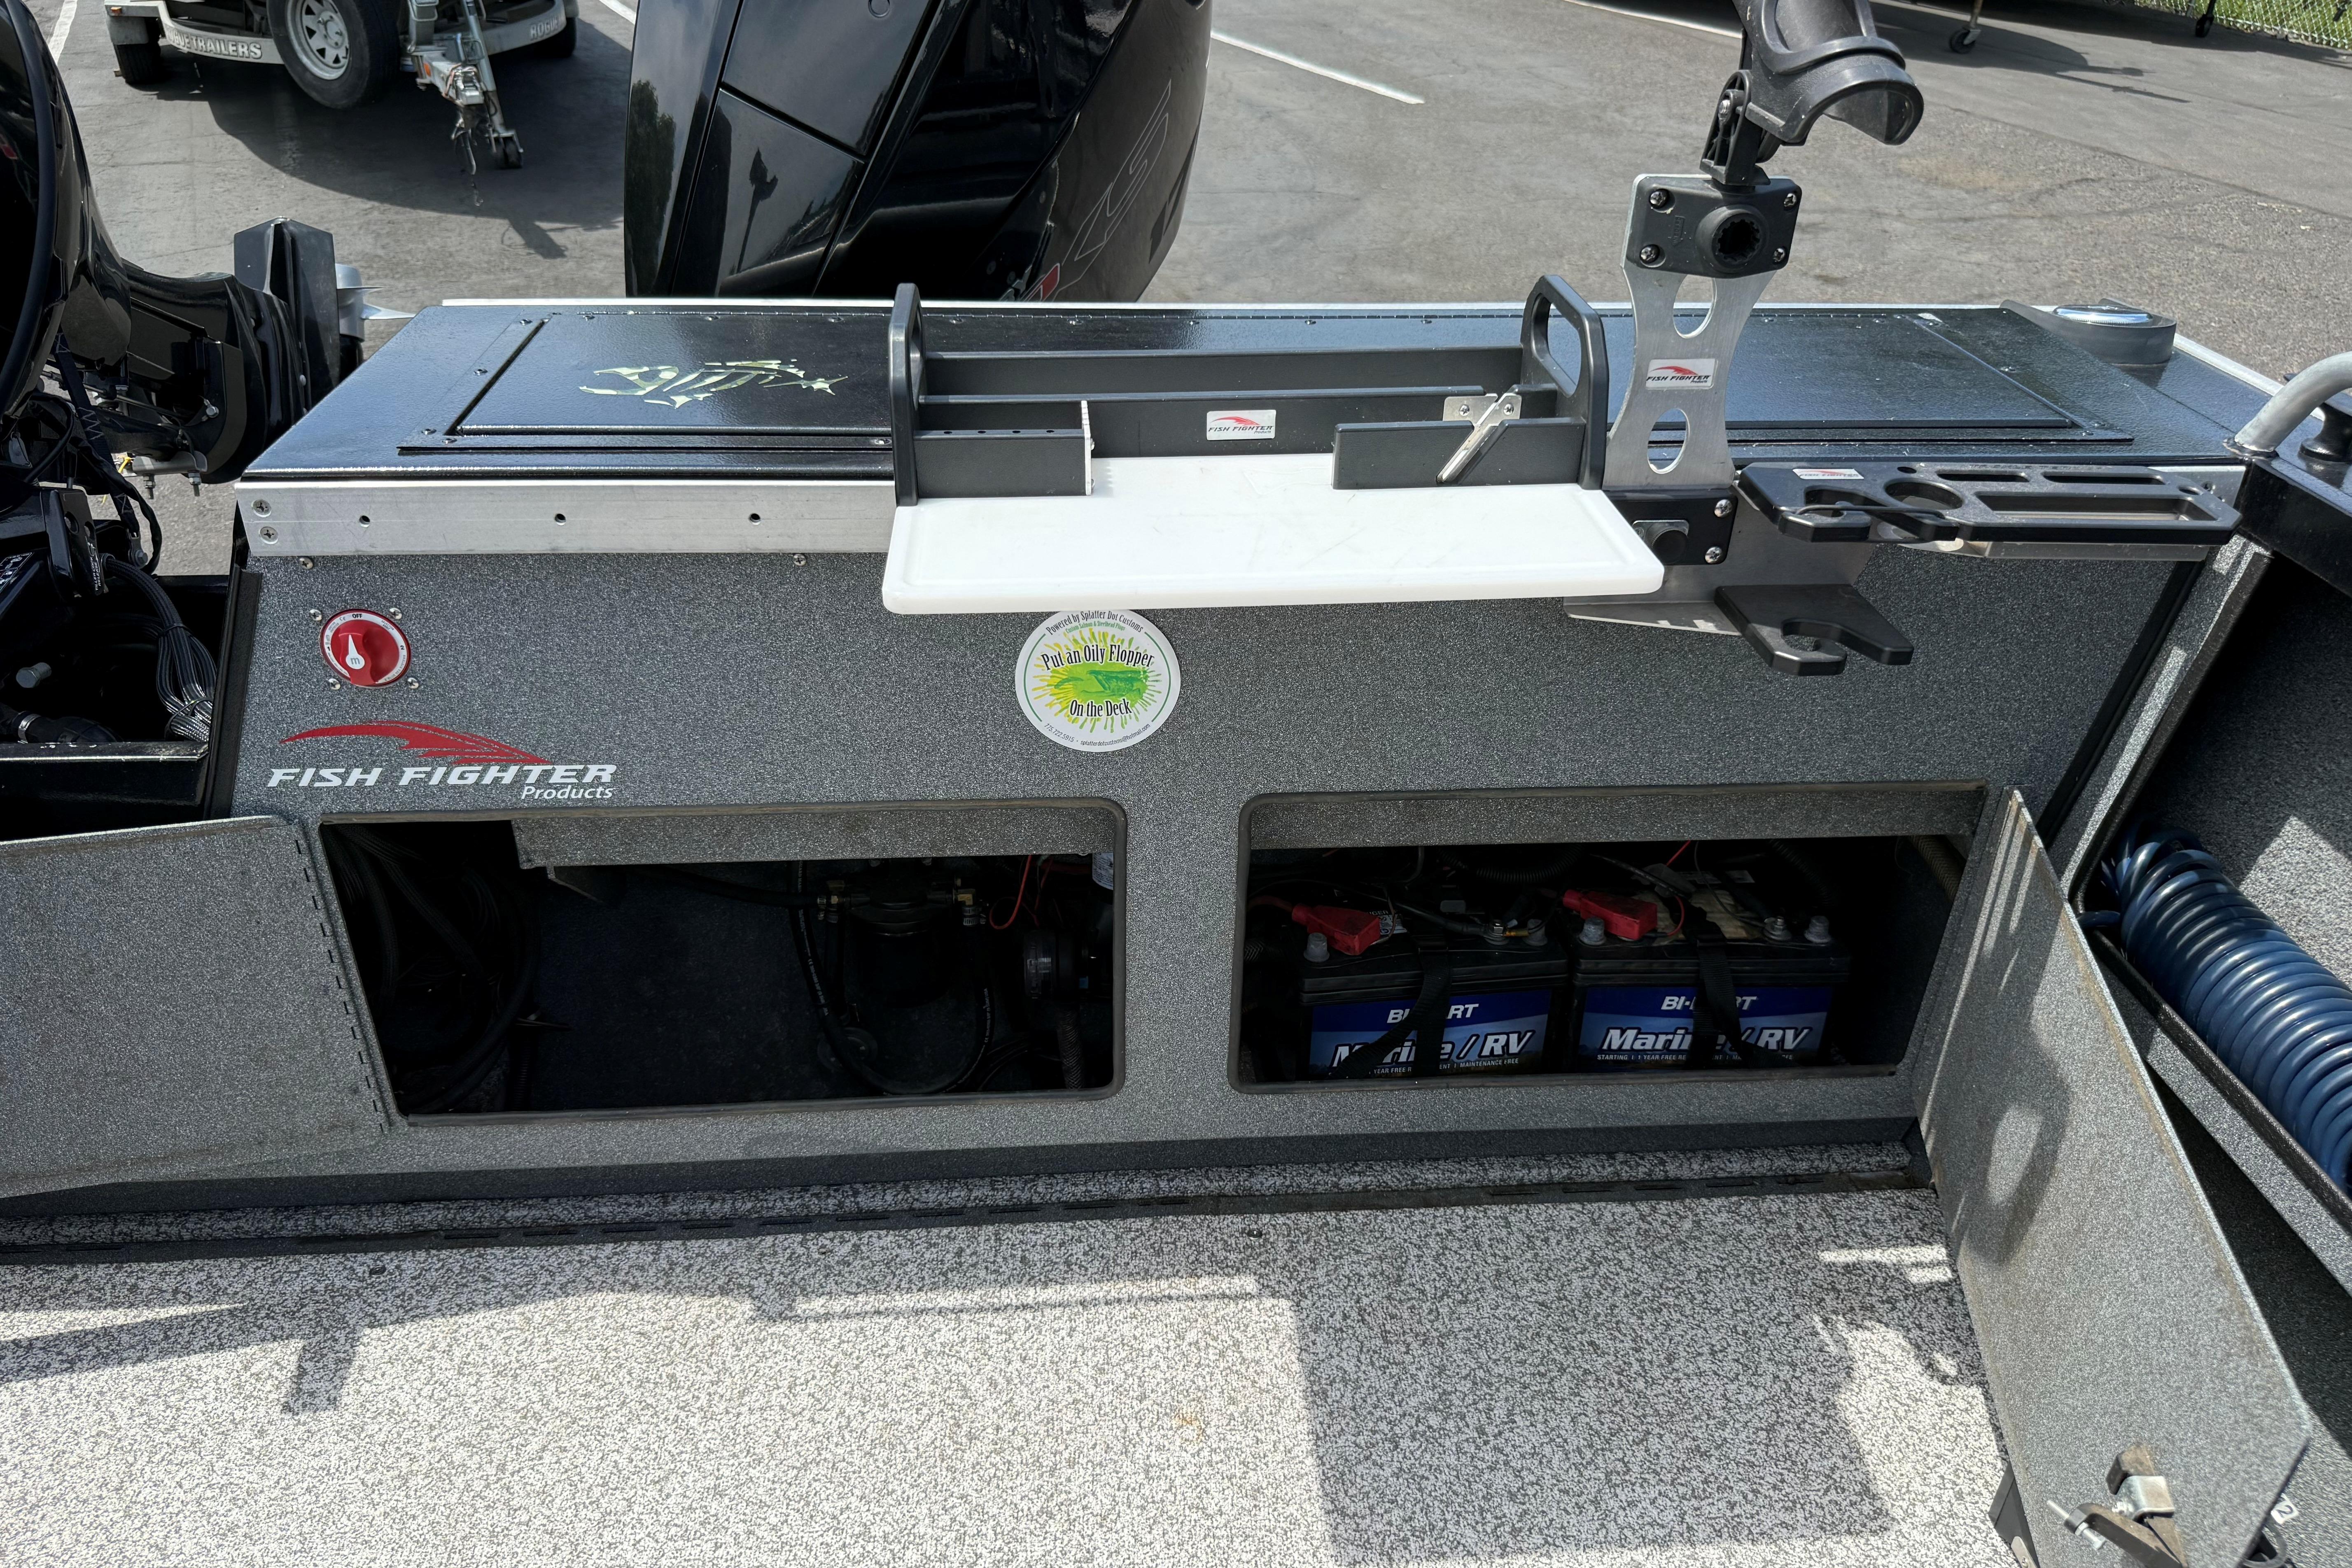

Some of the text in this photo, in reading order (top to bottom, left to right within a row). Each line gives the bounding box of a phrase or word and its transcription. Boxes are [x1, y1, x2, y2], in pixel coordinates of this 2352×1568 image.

[191, 35, 263, 59] TRAILERS
[1045, 610, 1143, 635] Powered by Splatter Dot Customs
[1041, 644, 1155, 671] Put an Oily Flopper
[1070, 698, 1132, 716] On the Deck
[1044, 723, 1151, 746] 775.722.5915 splatterdotcustoms@hotmail.com
[267, 764, 617, 787] FISH FIGHTER
[521, 785, 614, 800] Products
[1480, 1031, 1535, 1057] RV
[1756, 1029, 1811, 1050] RV
[1459, 1059, 1502, 1068] MAINTENANCE
